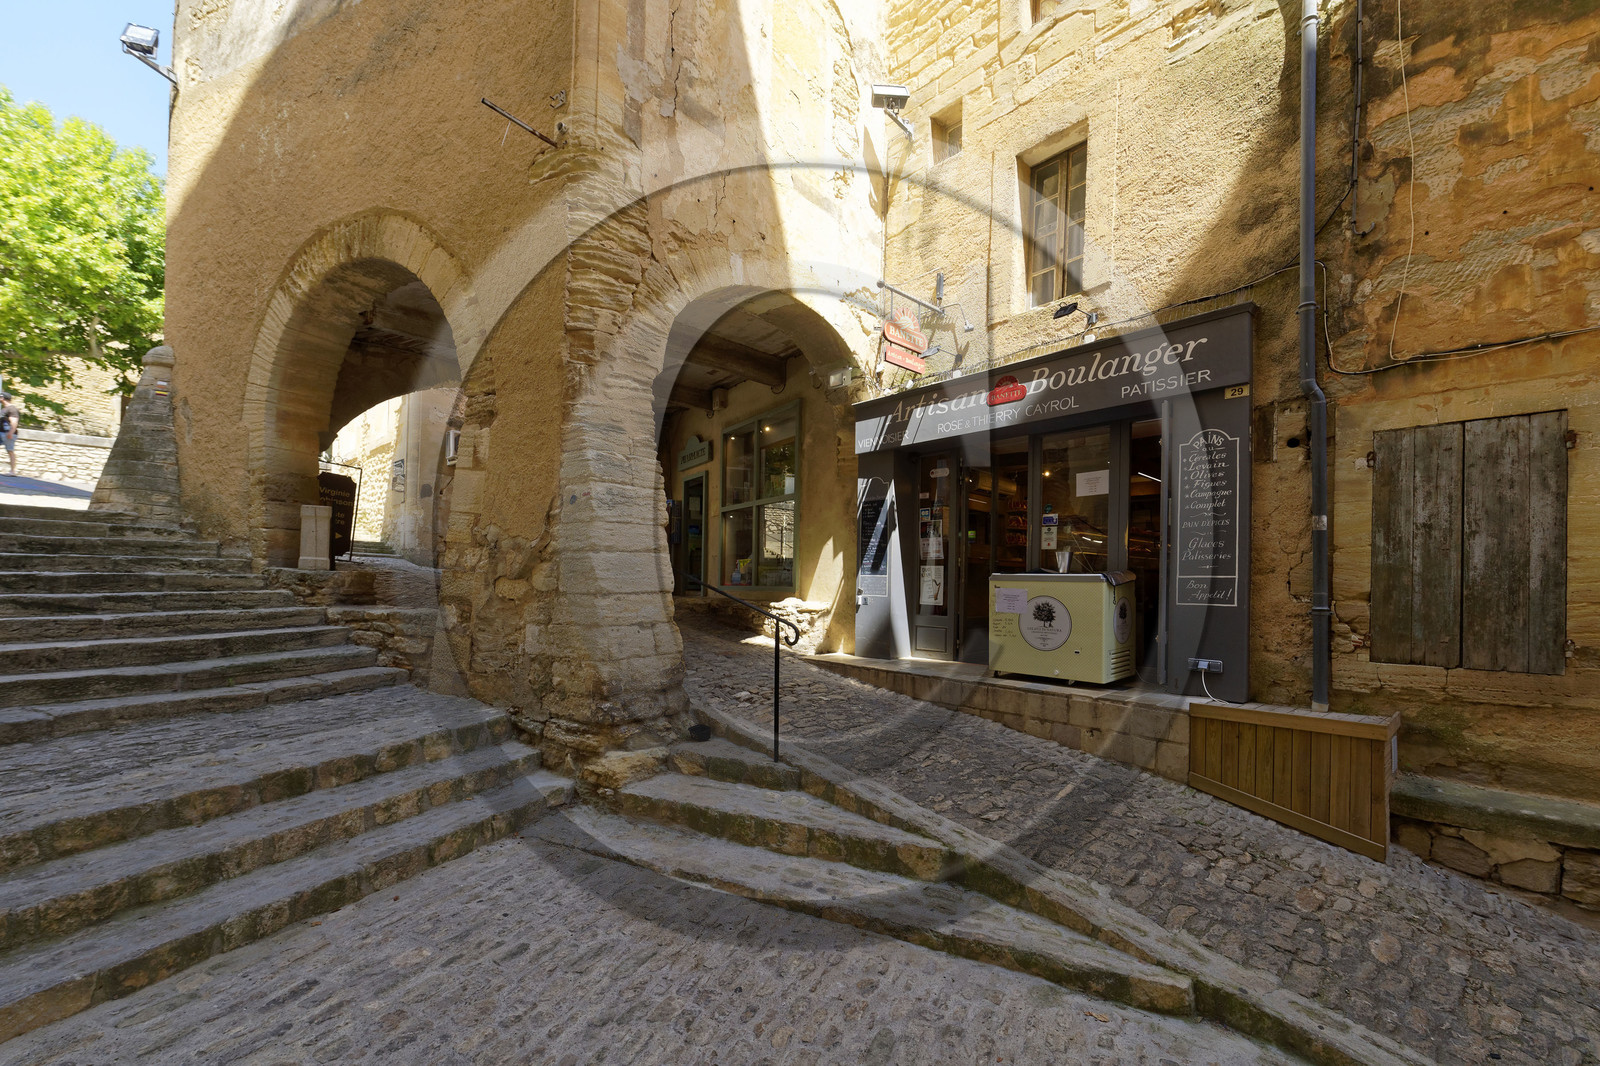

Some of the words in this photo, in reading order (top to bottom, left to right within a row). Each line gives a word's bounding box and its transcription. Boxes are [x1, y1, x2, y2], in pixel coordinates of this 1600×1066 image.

[889, 325, 924, 347] BANETTE
[887, 388, 988, 425] Artisan
[1027, 337, 1208, 396] Boulanger
[1121, 369, 1212, 399] PATISSIER
[991, 389, 1021, 401] BANETTE
[1231, 387, 1244, 396] 29
[937, 420, 963, 433] ROSE
[972, 407, 1020, 427] THIERRY
[1025, 396, 1080, 417] CAYROL
[858, 431, 910, 448] VIENNOISIER
[1188, 460, 1230, 471] Levain
[1190, 470, 1226, 480] Olives
[1193, 480, 1228, 490] Figues
[1190, 489, 1232, 499] Campagne
[1190, 499, 1226, 511] Complet
[1182, 520, 1200, 528] PAIN
[1188, 537, 1225, 552] Glaces
[1185, 579, 1208, 589] Bon
